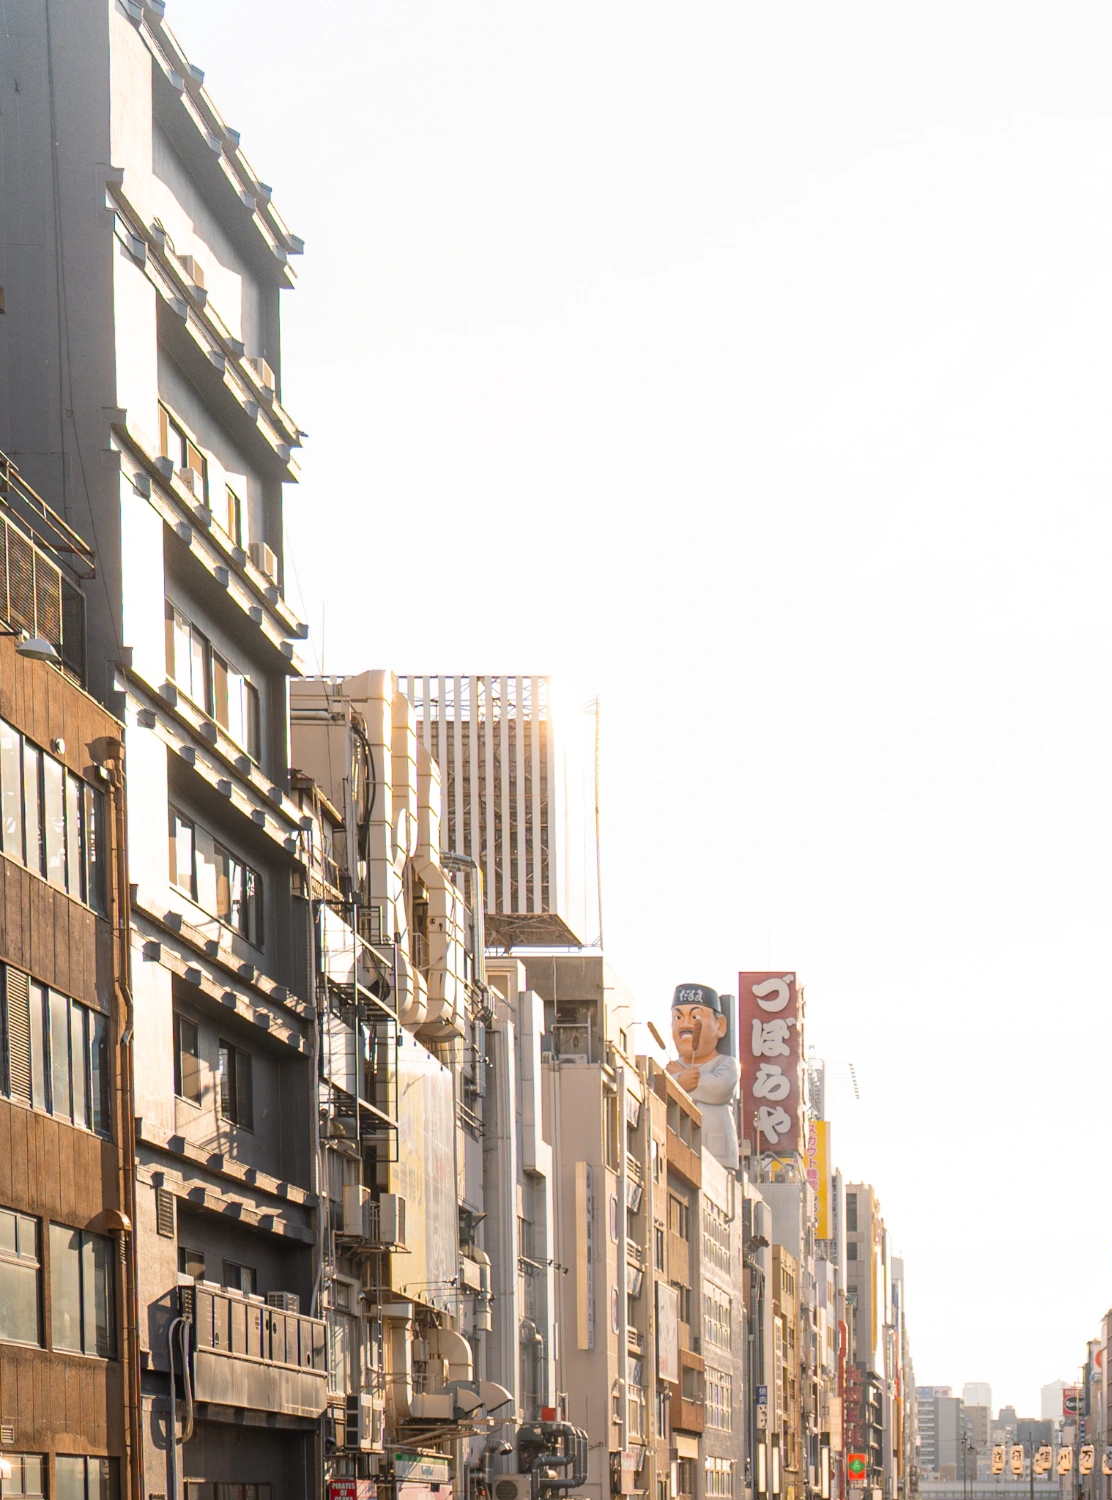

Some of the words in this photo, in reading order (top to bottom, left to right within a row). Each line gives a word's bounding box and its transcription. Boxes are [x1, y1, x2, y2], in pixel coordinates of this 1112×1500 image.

[678, 987, 704, 1003] だるま
[751, 973, 797, 1145] づぼらや
